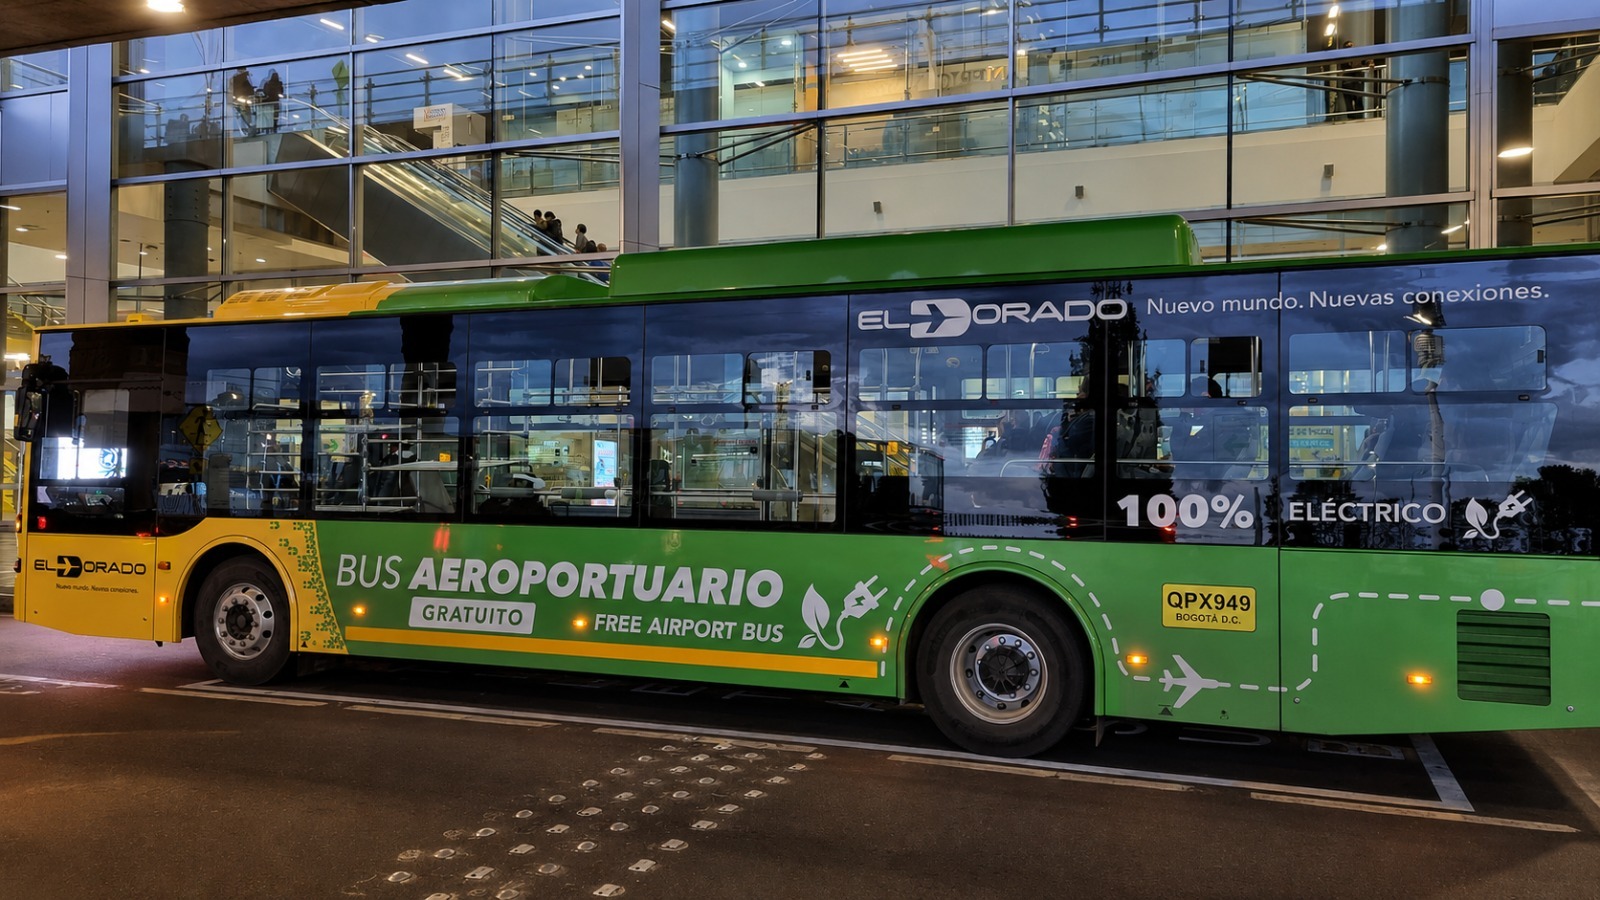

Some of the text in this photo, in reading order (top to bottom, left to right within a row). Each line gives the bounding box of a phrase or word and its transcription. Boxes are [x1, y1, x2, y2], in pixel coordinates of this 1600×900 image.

[1147, 283, 1551, 315] Nuevo mundo. Nuevas conexiones.
[857, 310, 911, 331] EL
[1117, 494, 1446, 530] 100% ELÉCTRICO
[34, 559, 57, 571] EL
[336, 553, 785, 608] BUS AEROPORTUARIO
[1167, 591, 1251, 612] QPX949
[422, 604, 524, 626] GRATUITO
[1176, 612, 1242, 625] BOGOTÁ D.C.
[594, 613, 784, 644] FREE AIRPORT BUS
